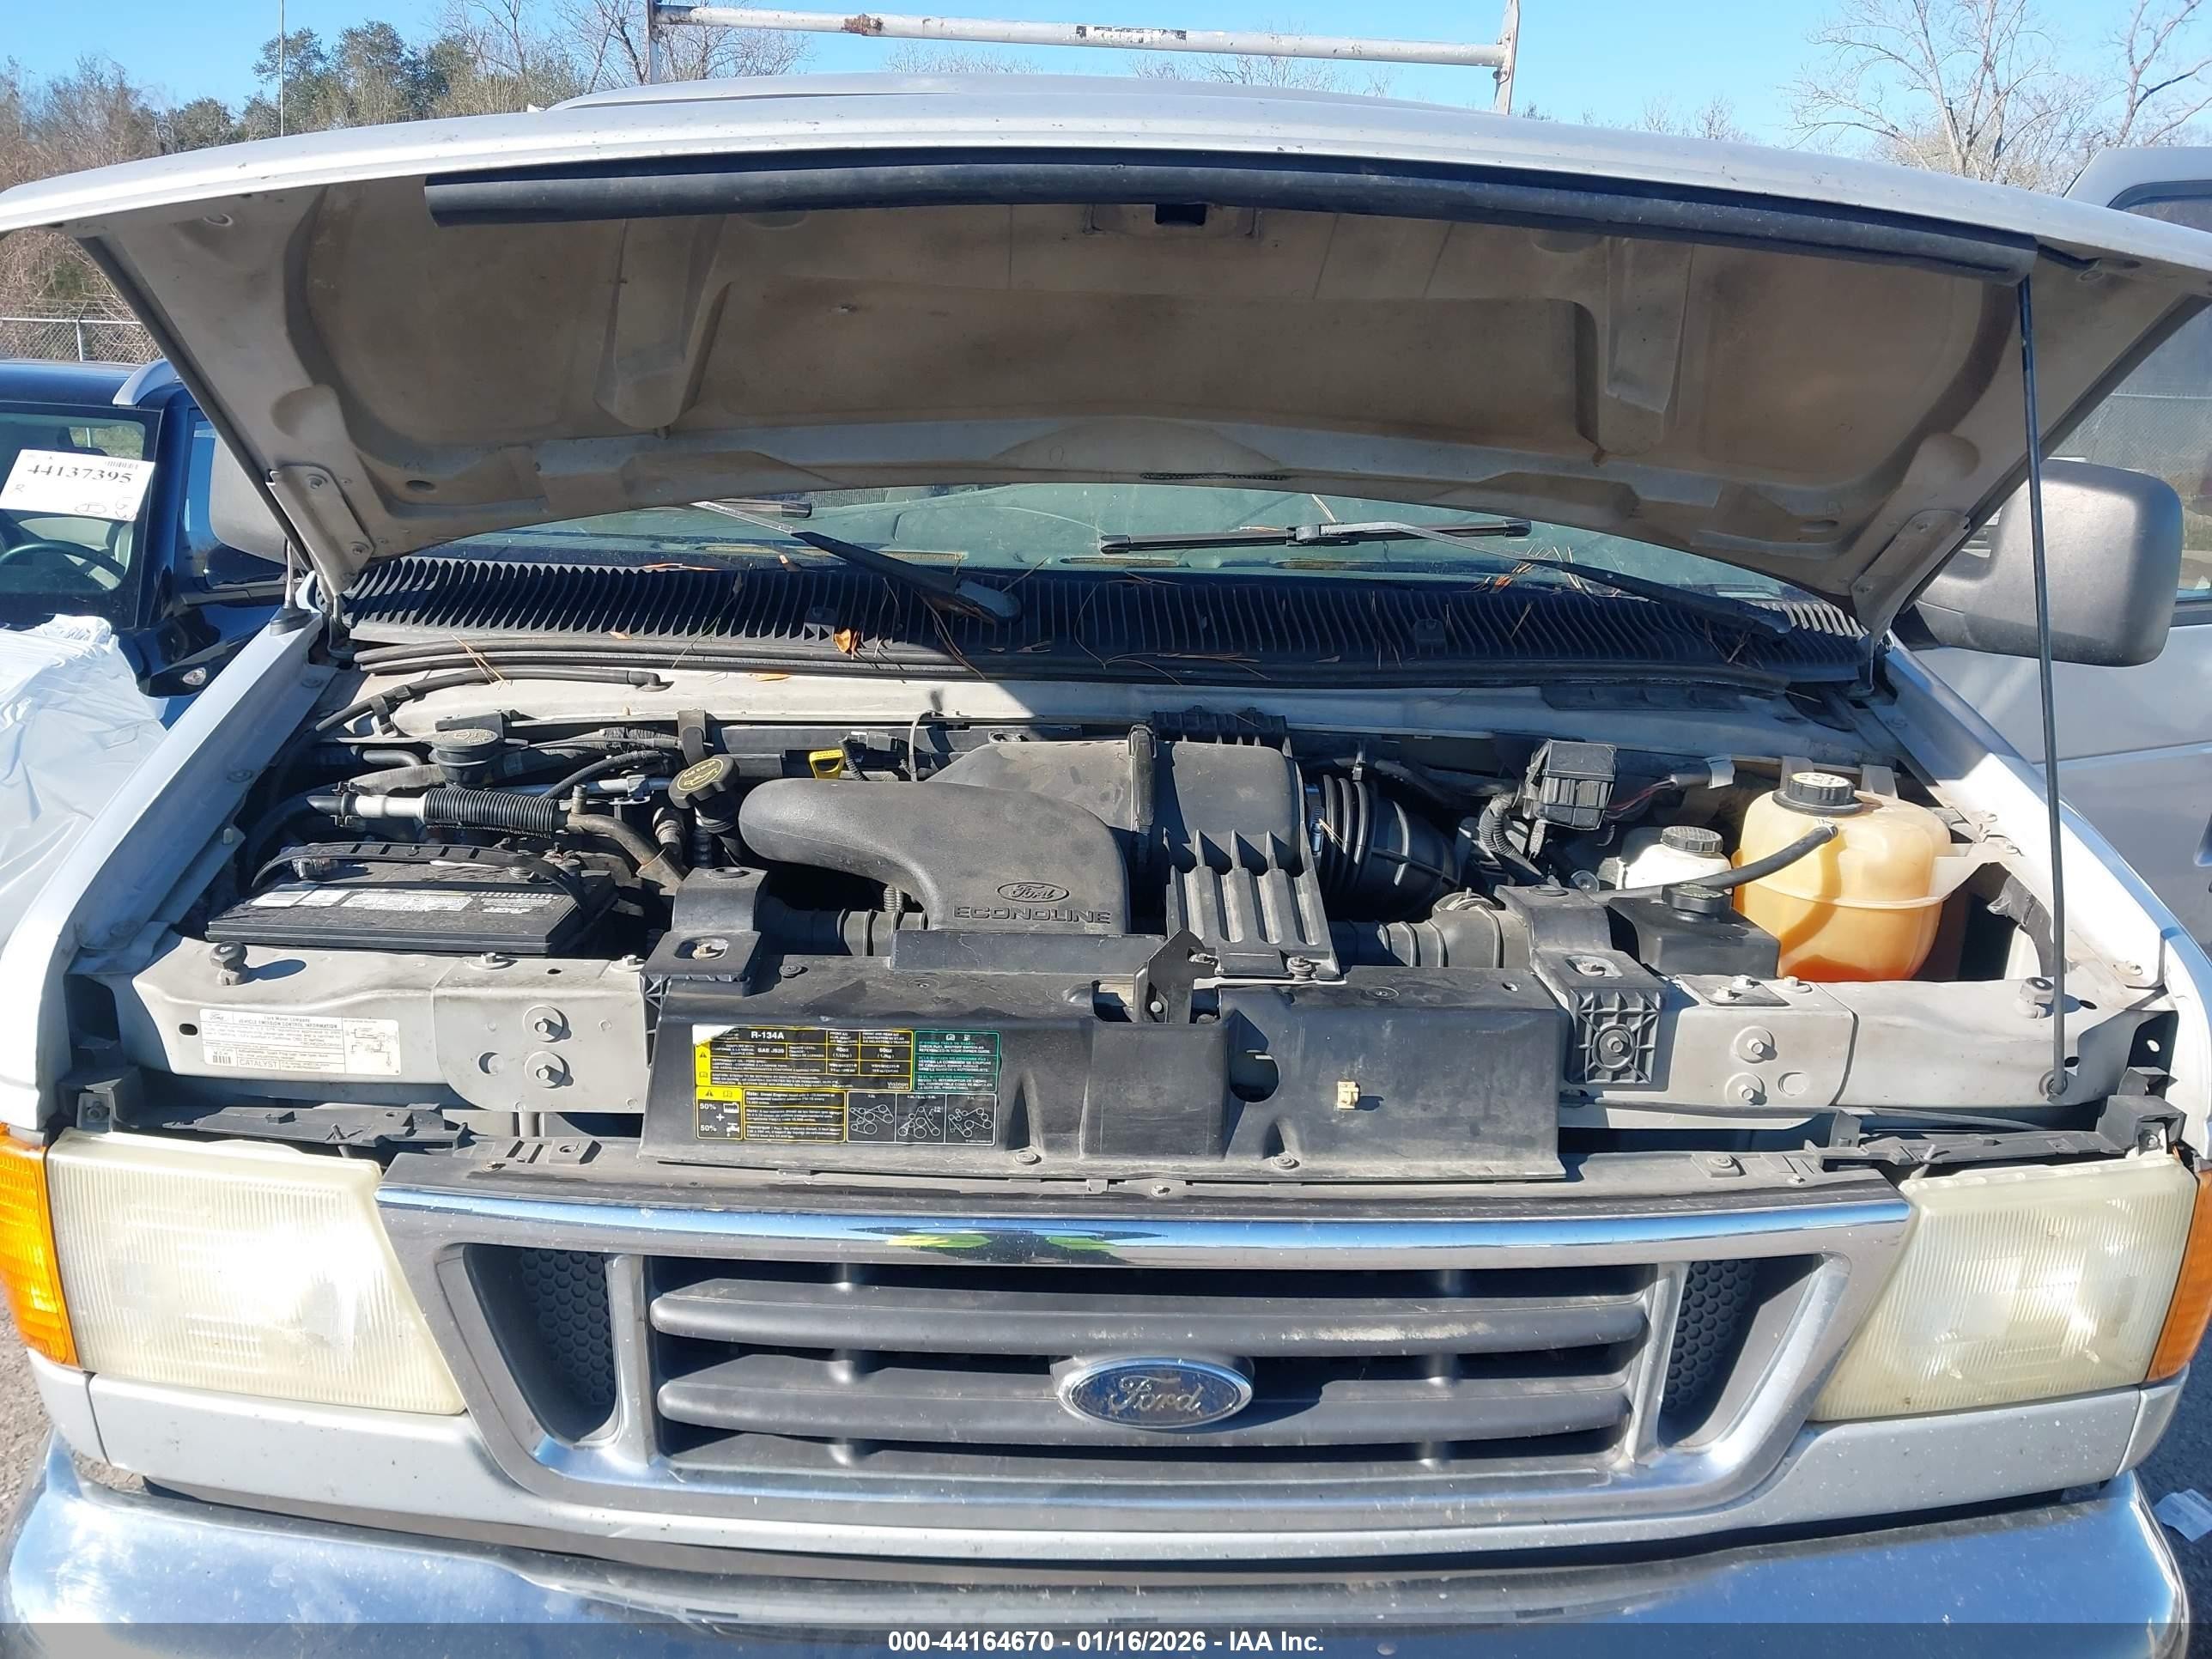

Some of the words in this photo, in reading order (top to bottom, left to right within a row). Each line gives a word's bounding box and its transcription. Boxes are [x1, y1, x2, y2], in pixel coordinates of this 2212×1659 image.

[27, 464, 132, 483] 44137395
[1012, 884, 1055, 899] Ford
[953, 905, 1111, 924] ECONOLINE
[240, 1059, 277, 1068] CATALYST
[1108, 1375, 1204, 1412] Ford
